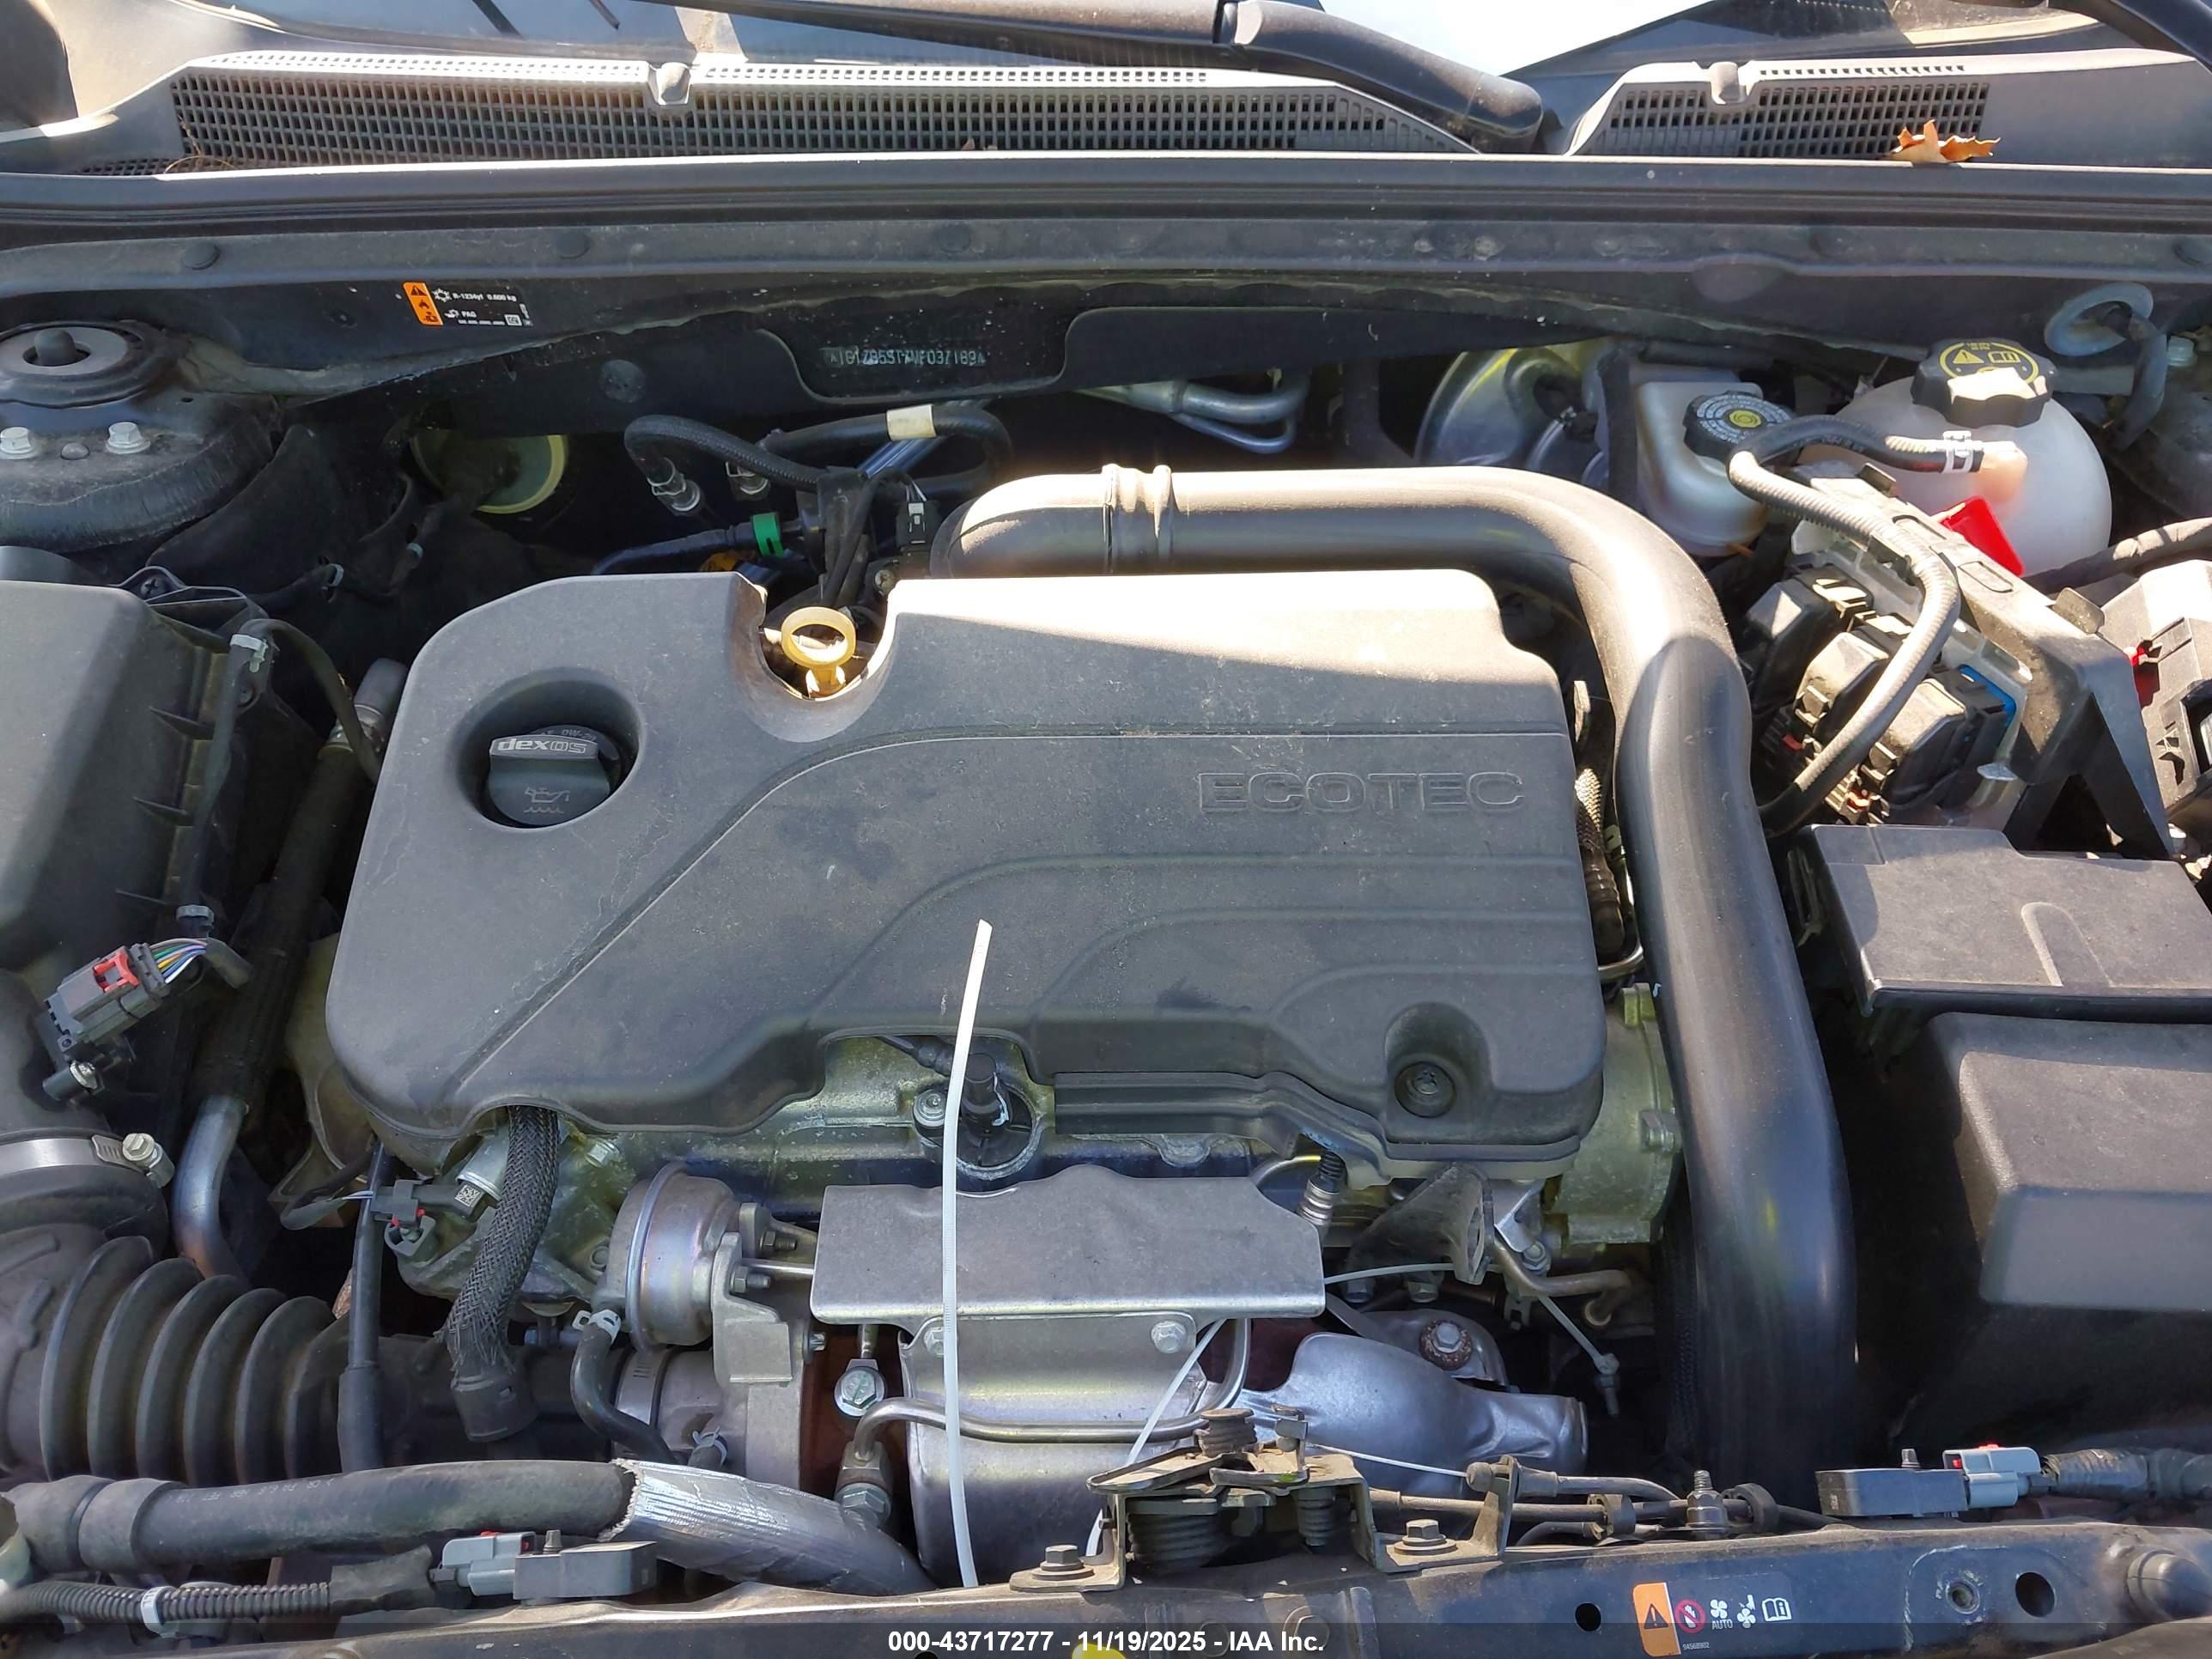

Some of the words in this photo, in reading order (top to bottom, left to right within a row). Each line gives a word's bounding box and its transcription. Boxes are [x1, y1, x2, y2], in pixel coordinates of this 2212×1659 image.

[497, 738, 587, 754] dexos
[1198, 771, 1524, 813] ECOTEC
[1711, 1619, 1734, 1630] AUTO
